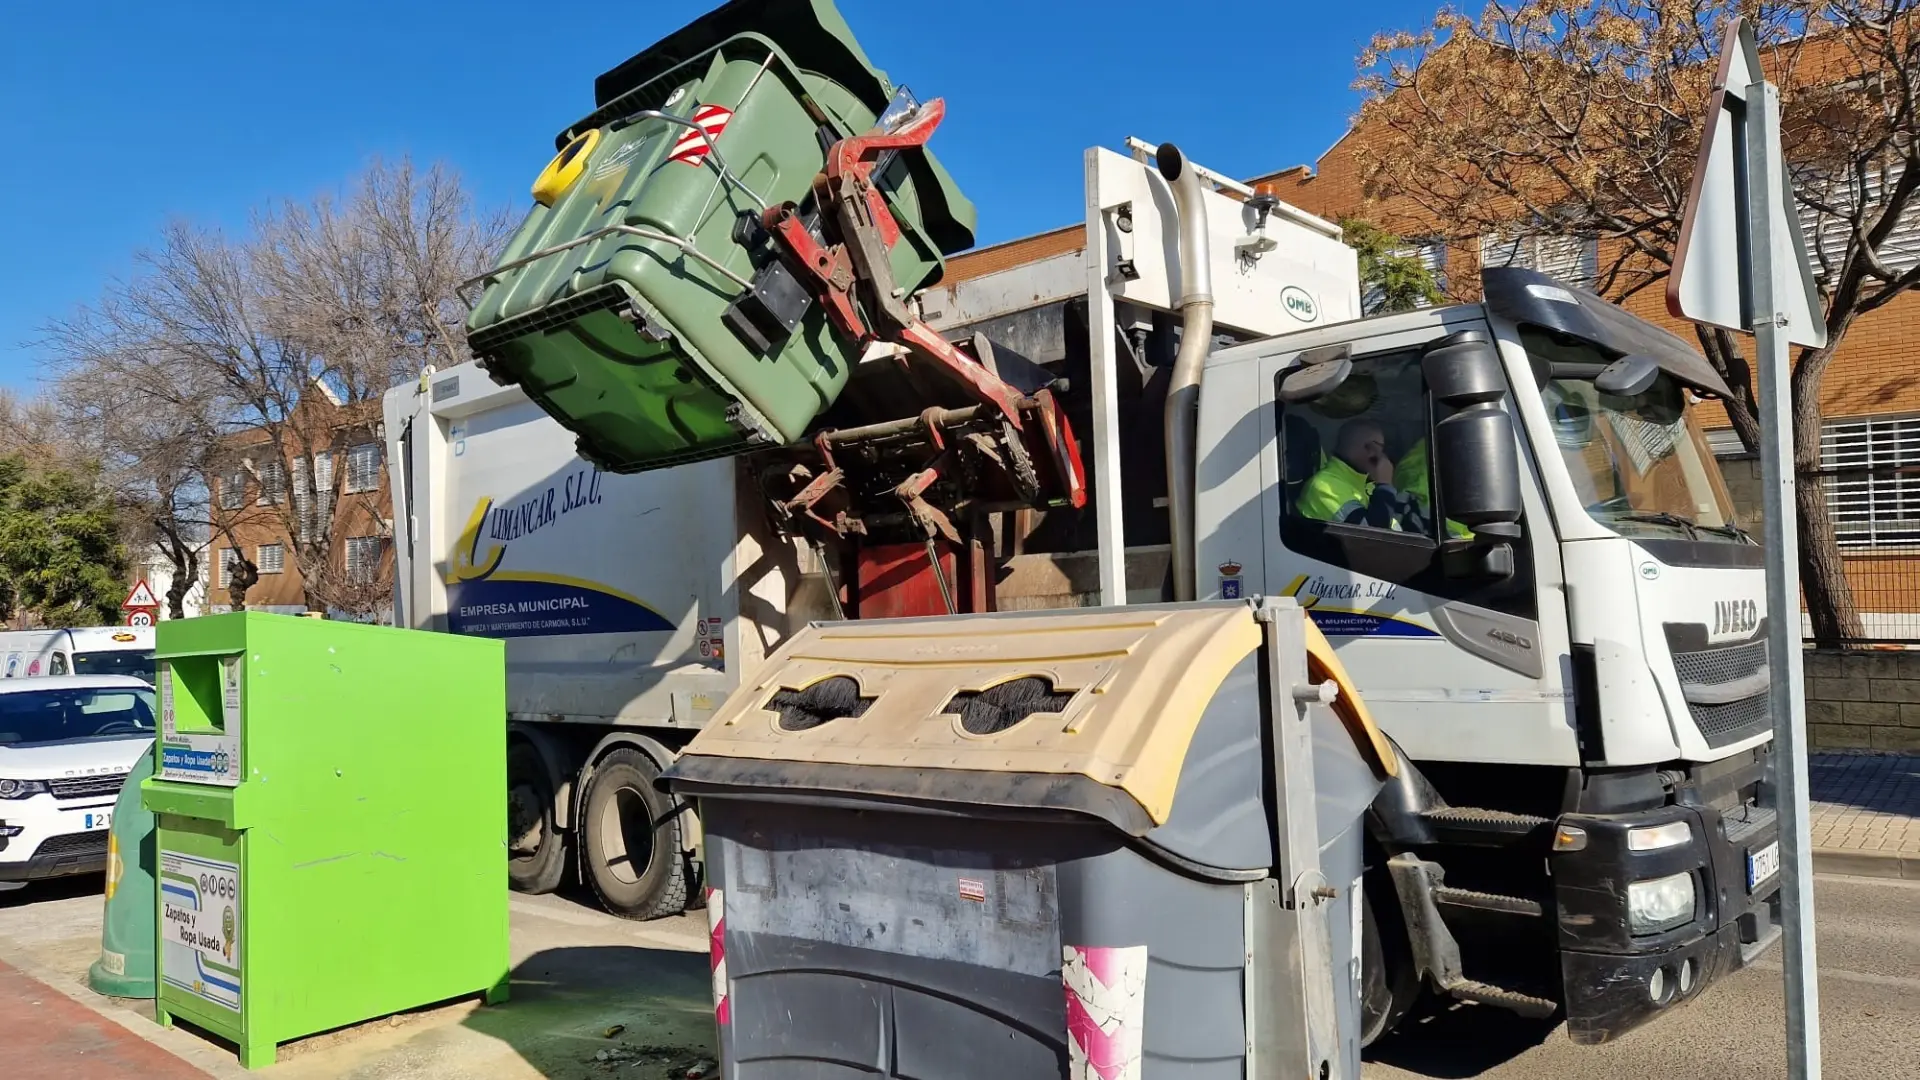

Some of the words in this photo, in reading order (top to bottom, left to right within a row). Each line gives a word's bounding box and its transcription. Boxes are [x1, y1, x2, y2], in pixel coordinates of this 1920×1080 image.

[1286, 296, 1312, 314] OMB
[490, 487, 556, 542] LIMANCAR,
[561, 470, 602, 515] S.L.U.
[1366, 582, 1397, 601] S.L.U.
[460, 602, 516, 617] EMPRESA
[518, 596, 589, 613] MUNICIPAL
[1713, 599, 1757, 635] IVECO
[133, 617, 149, 626] 20
[533, 620, 540, 629] DE
[165, 903, 190, 925] Zapatos
[191, 914, 196, 928] y
[180, 926, 197, 946] Ropa
[198, 931, 220, 952] Usada
